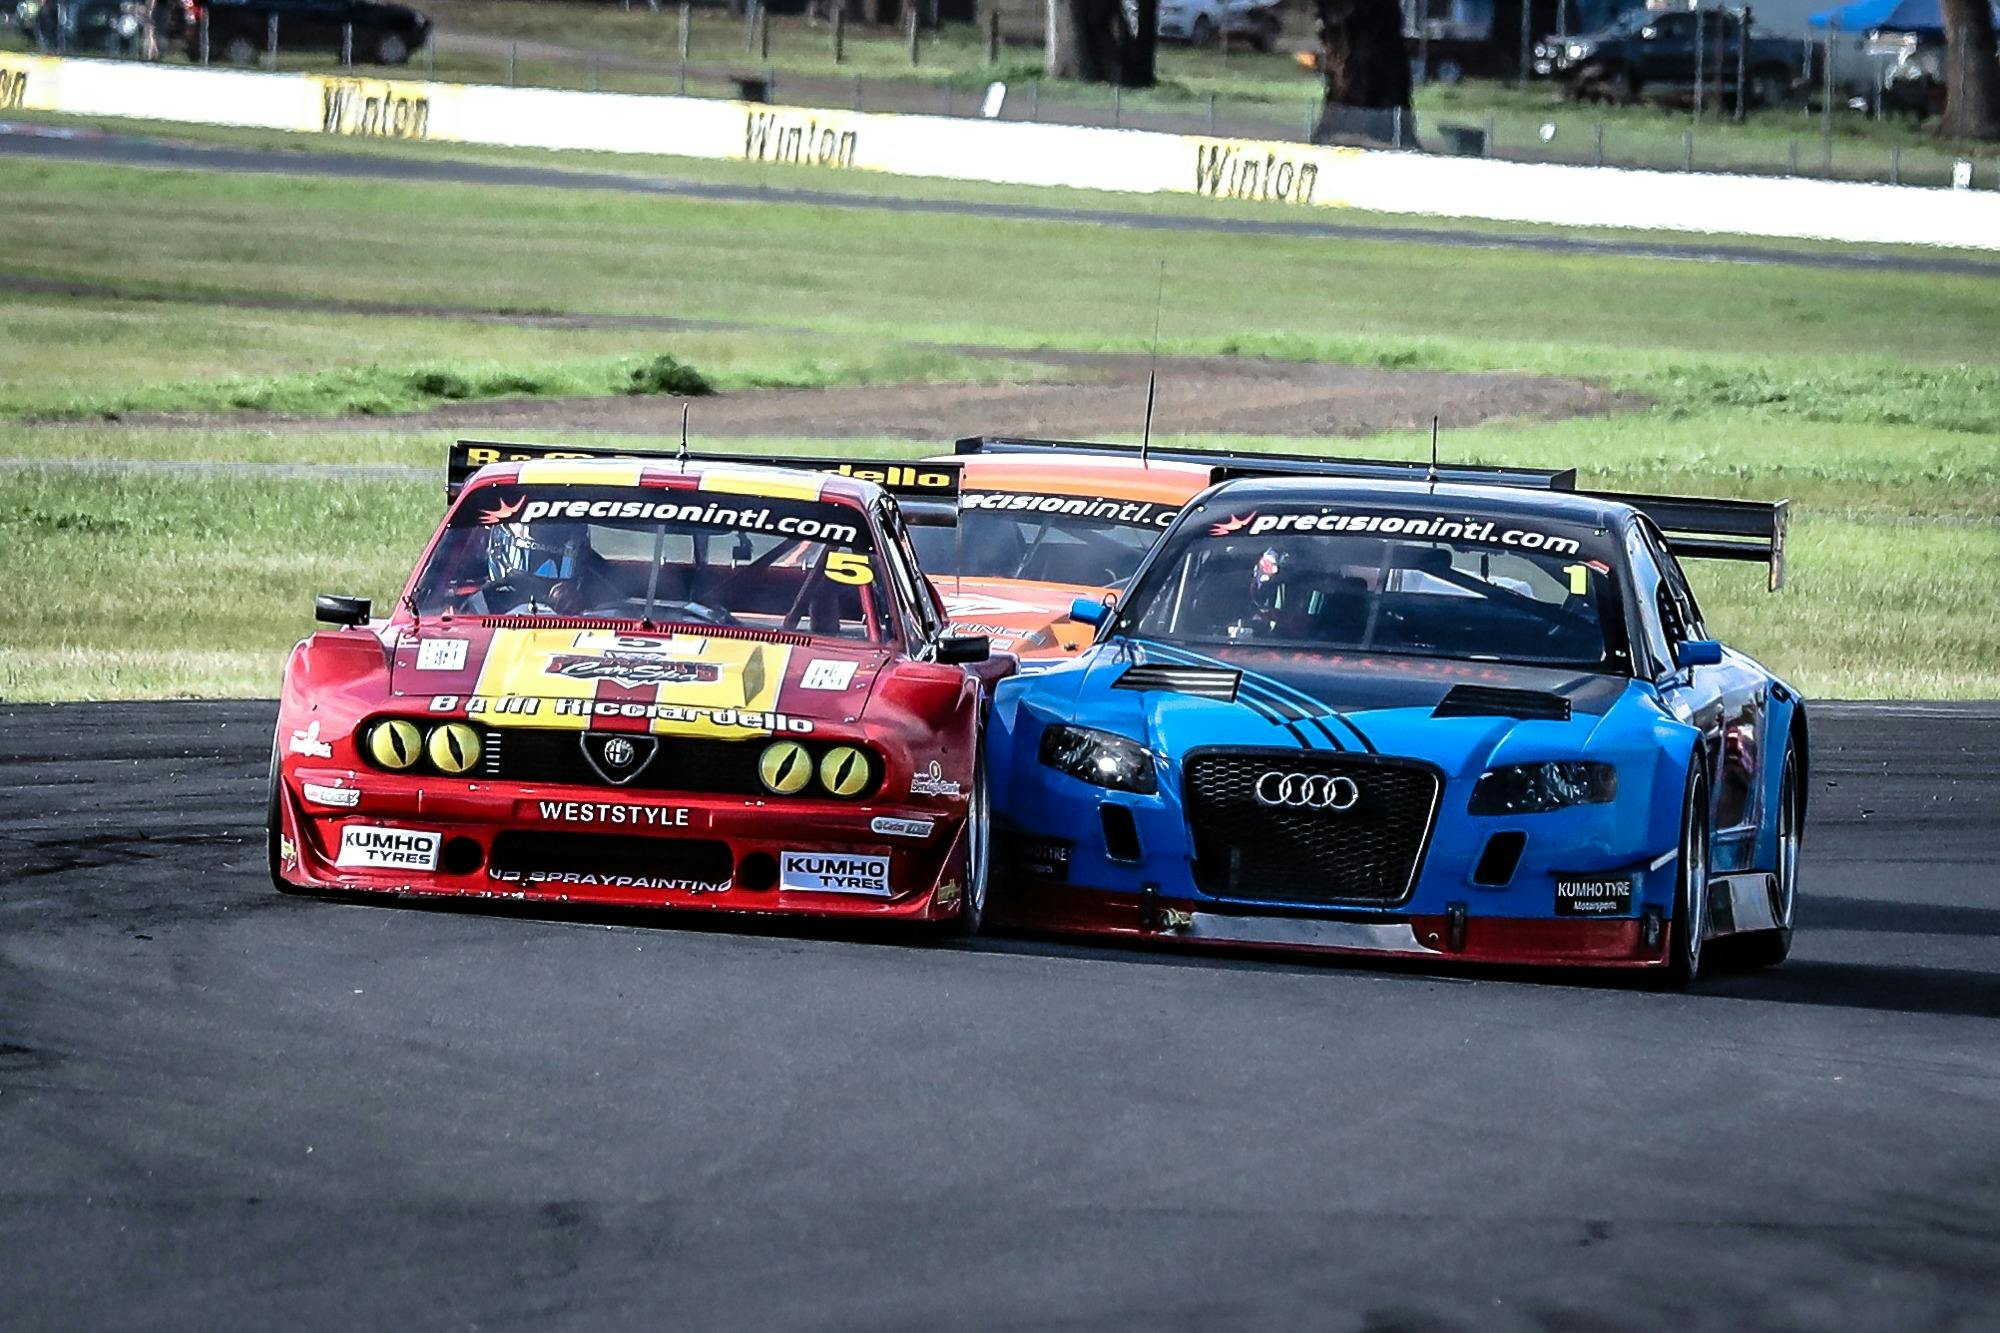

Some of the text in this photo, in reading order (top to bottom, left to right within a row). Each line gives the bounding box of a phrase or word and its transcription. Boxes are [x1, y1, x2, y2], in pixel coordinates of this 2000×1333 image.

[322, 81, 429, 138] Winton
[745, 111, 857, 168] Winton
[1197, 144, 1319, 204] Winton
[520, 499, 857, 543] precisionintl.com
[1249, 514, 1581, 555] precisionintl.com
[823, 551, 875, 586] 5
[1562, 564, 1588, 596] 1
[429, 695, 460, 712] B
[556, 698, 816, 733] Ricciardello
[539, 801, 690, 826] WESTSTYLE
[345, 832, 433, 853] KUMHO
[366, 849, 431, 865] TYRES
[787, 857, 886, 877] KUMHO
[818, 875, 885, 891] TYRES
[1557, 881, 1631, 897] KUMHO TYRE
